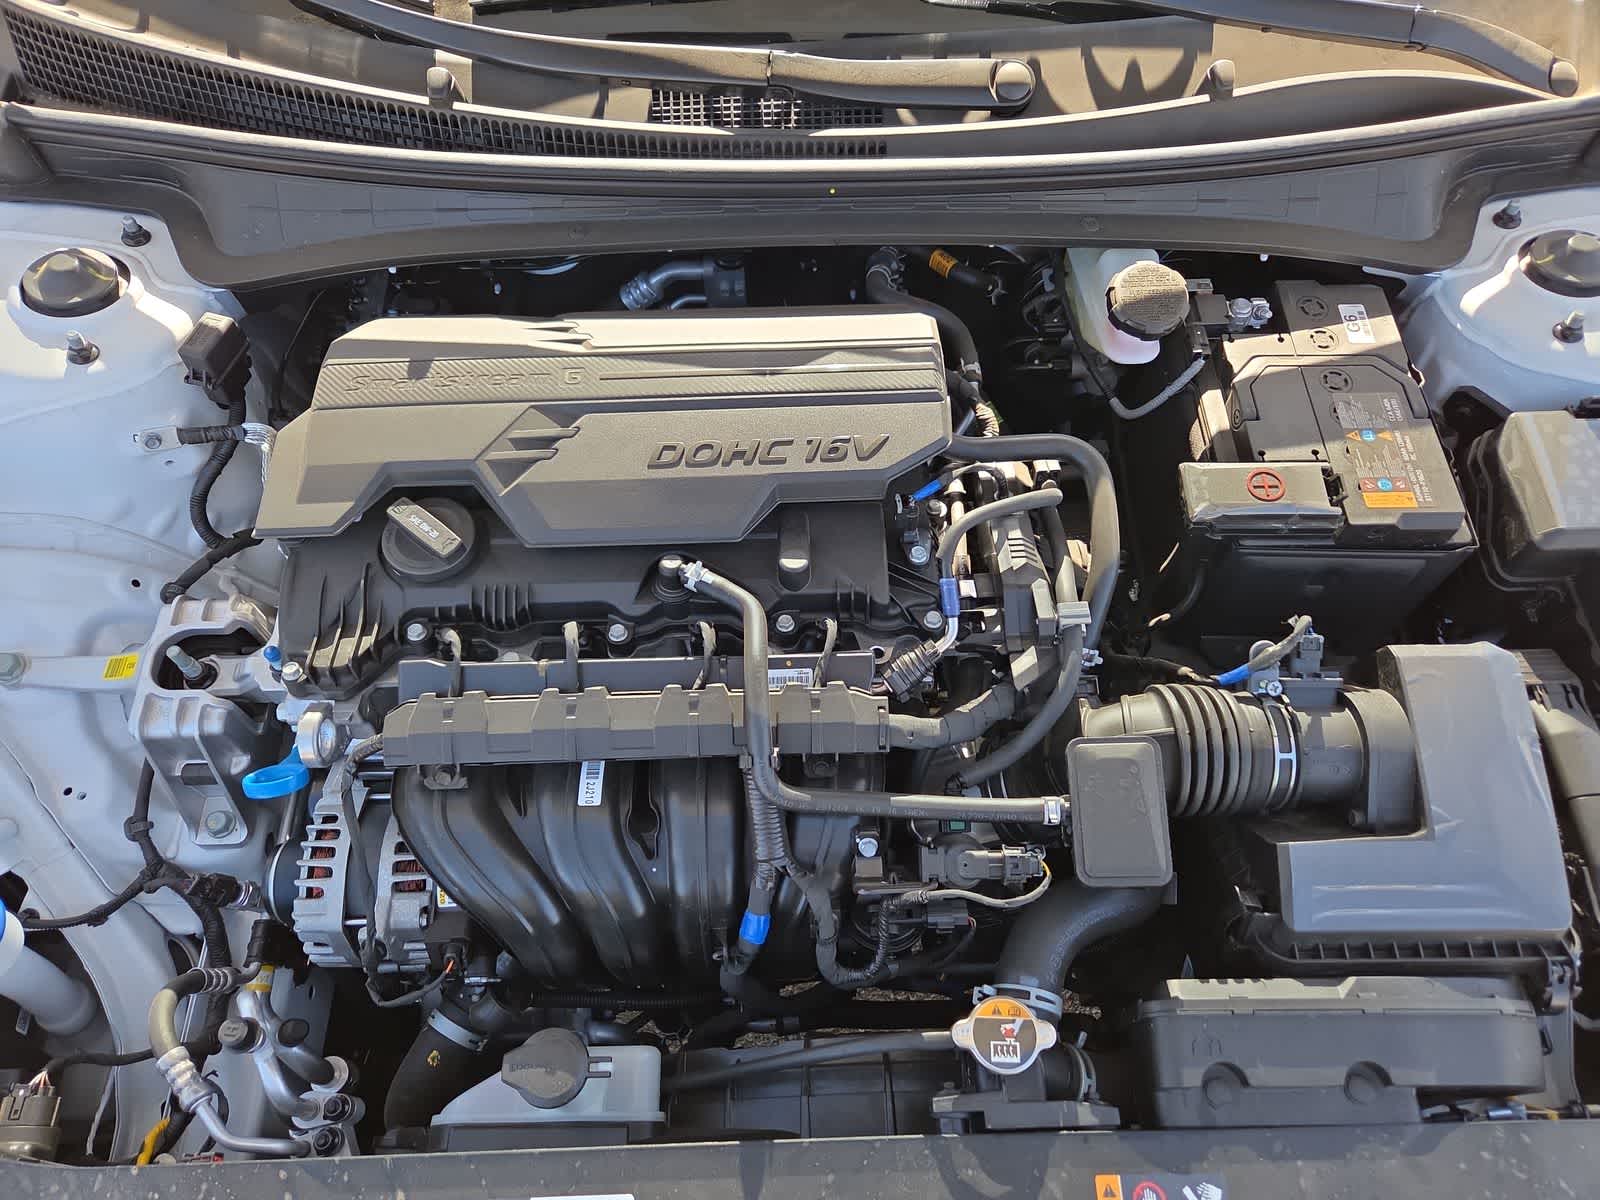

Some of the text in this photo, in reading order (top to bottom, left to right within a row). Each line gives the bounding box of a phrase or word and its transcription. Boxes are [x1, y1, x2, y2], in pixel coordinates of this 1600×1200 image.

[1343, 314, 1361, 332] G6
[647, 433, 891, 470] DOHC 16V
